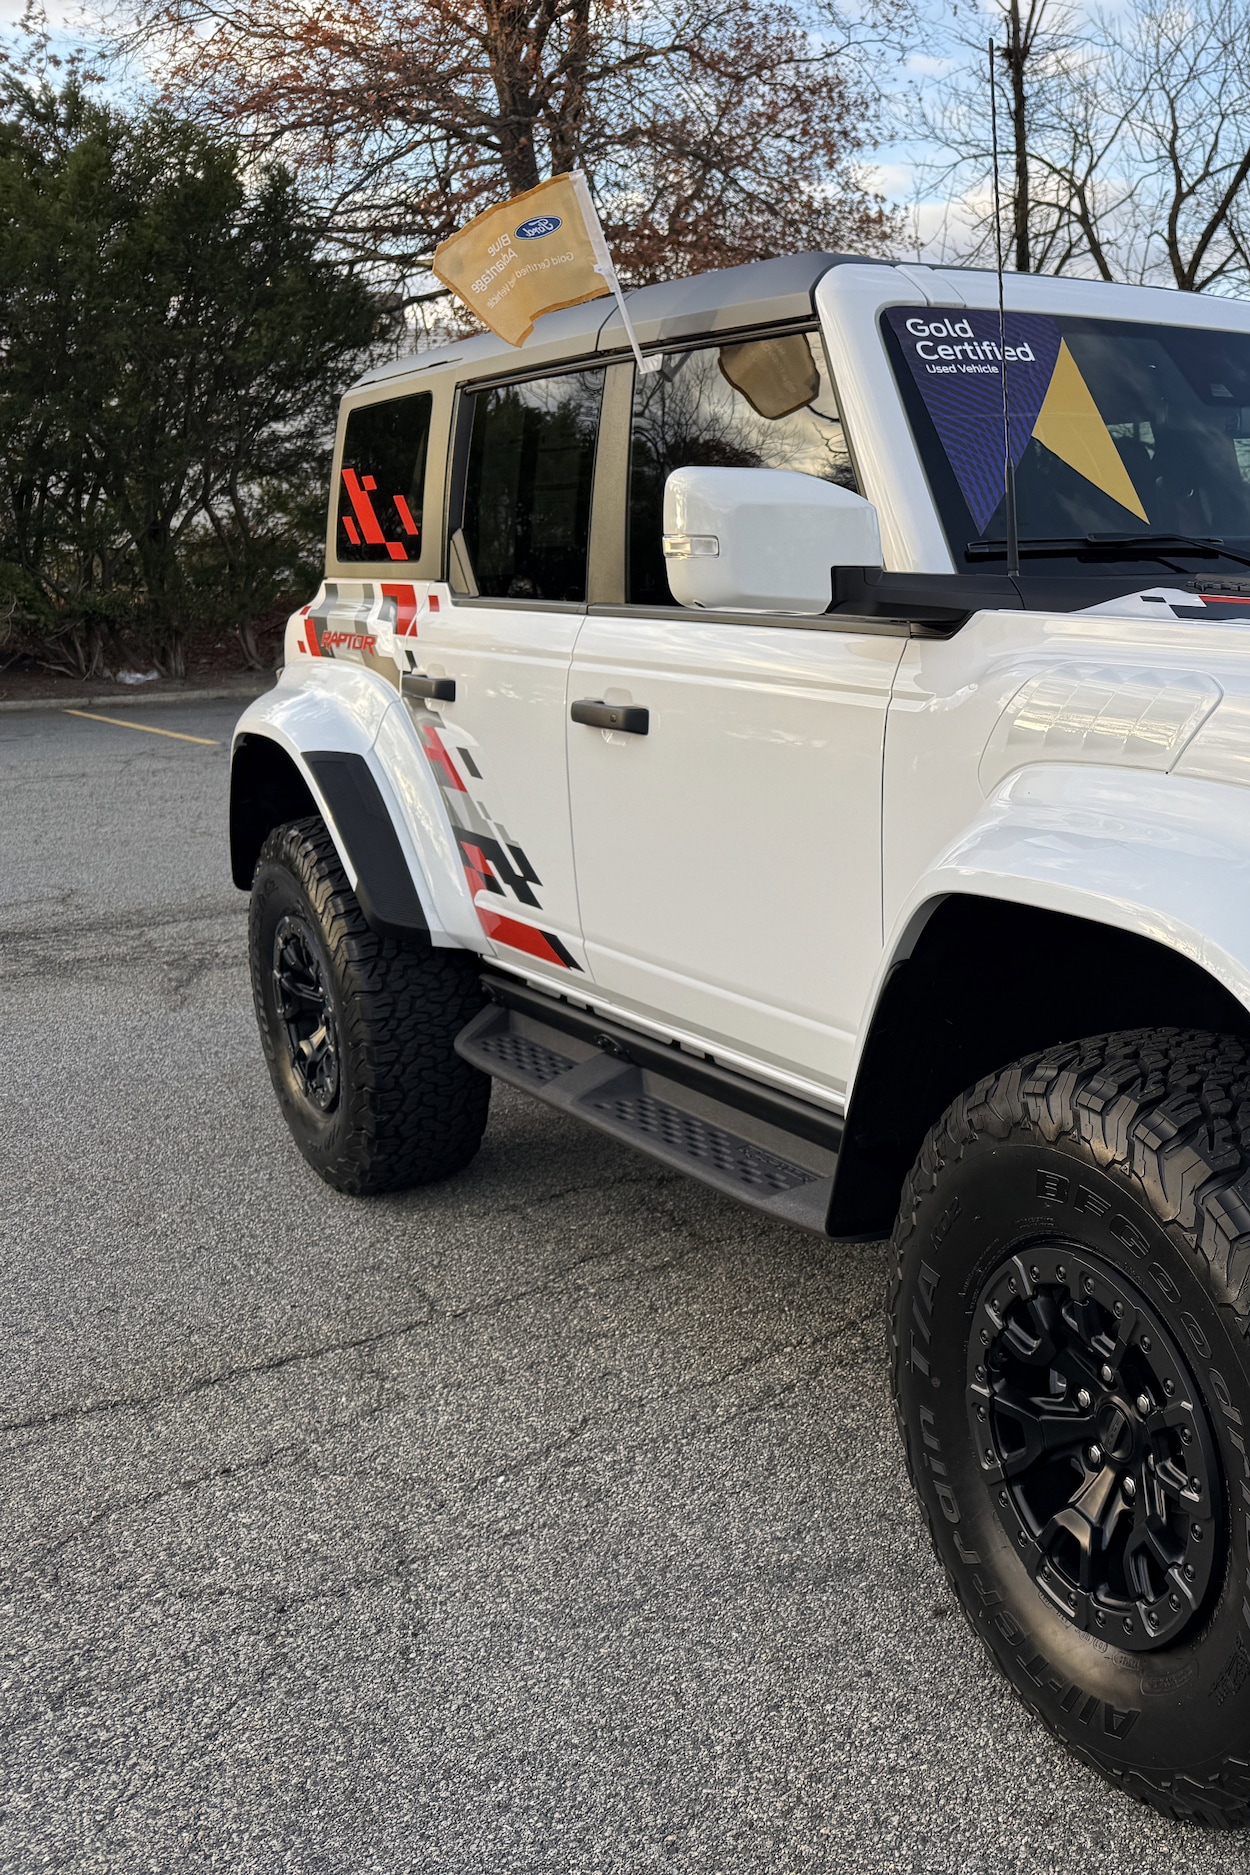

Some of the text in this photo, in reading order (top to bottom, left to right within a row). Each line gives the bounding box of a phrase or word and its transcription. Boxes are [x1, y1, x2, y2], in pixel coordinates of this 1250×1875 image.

[905, 318, 975, 338] Gold
[915, 341, 1036, 362] Certified
[926, 364, 1000, 374] Used Vehicle
[321, 630, 378, 656] RAPTOR
[909, 1258, 942, 1378] T/A
[918, 1404, 1142, 1740] All-Terrain
